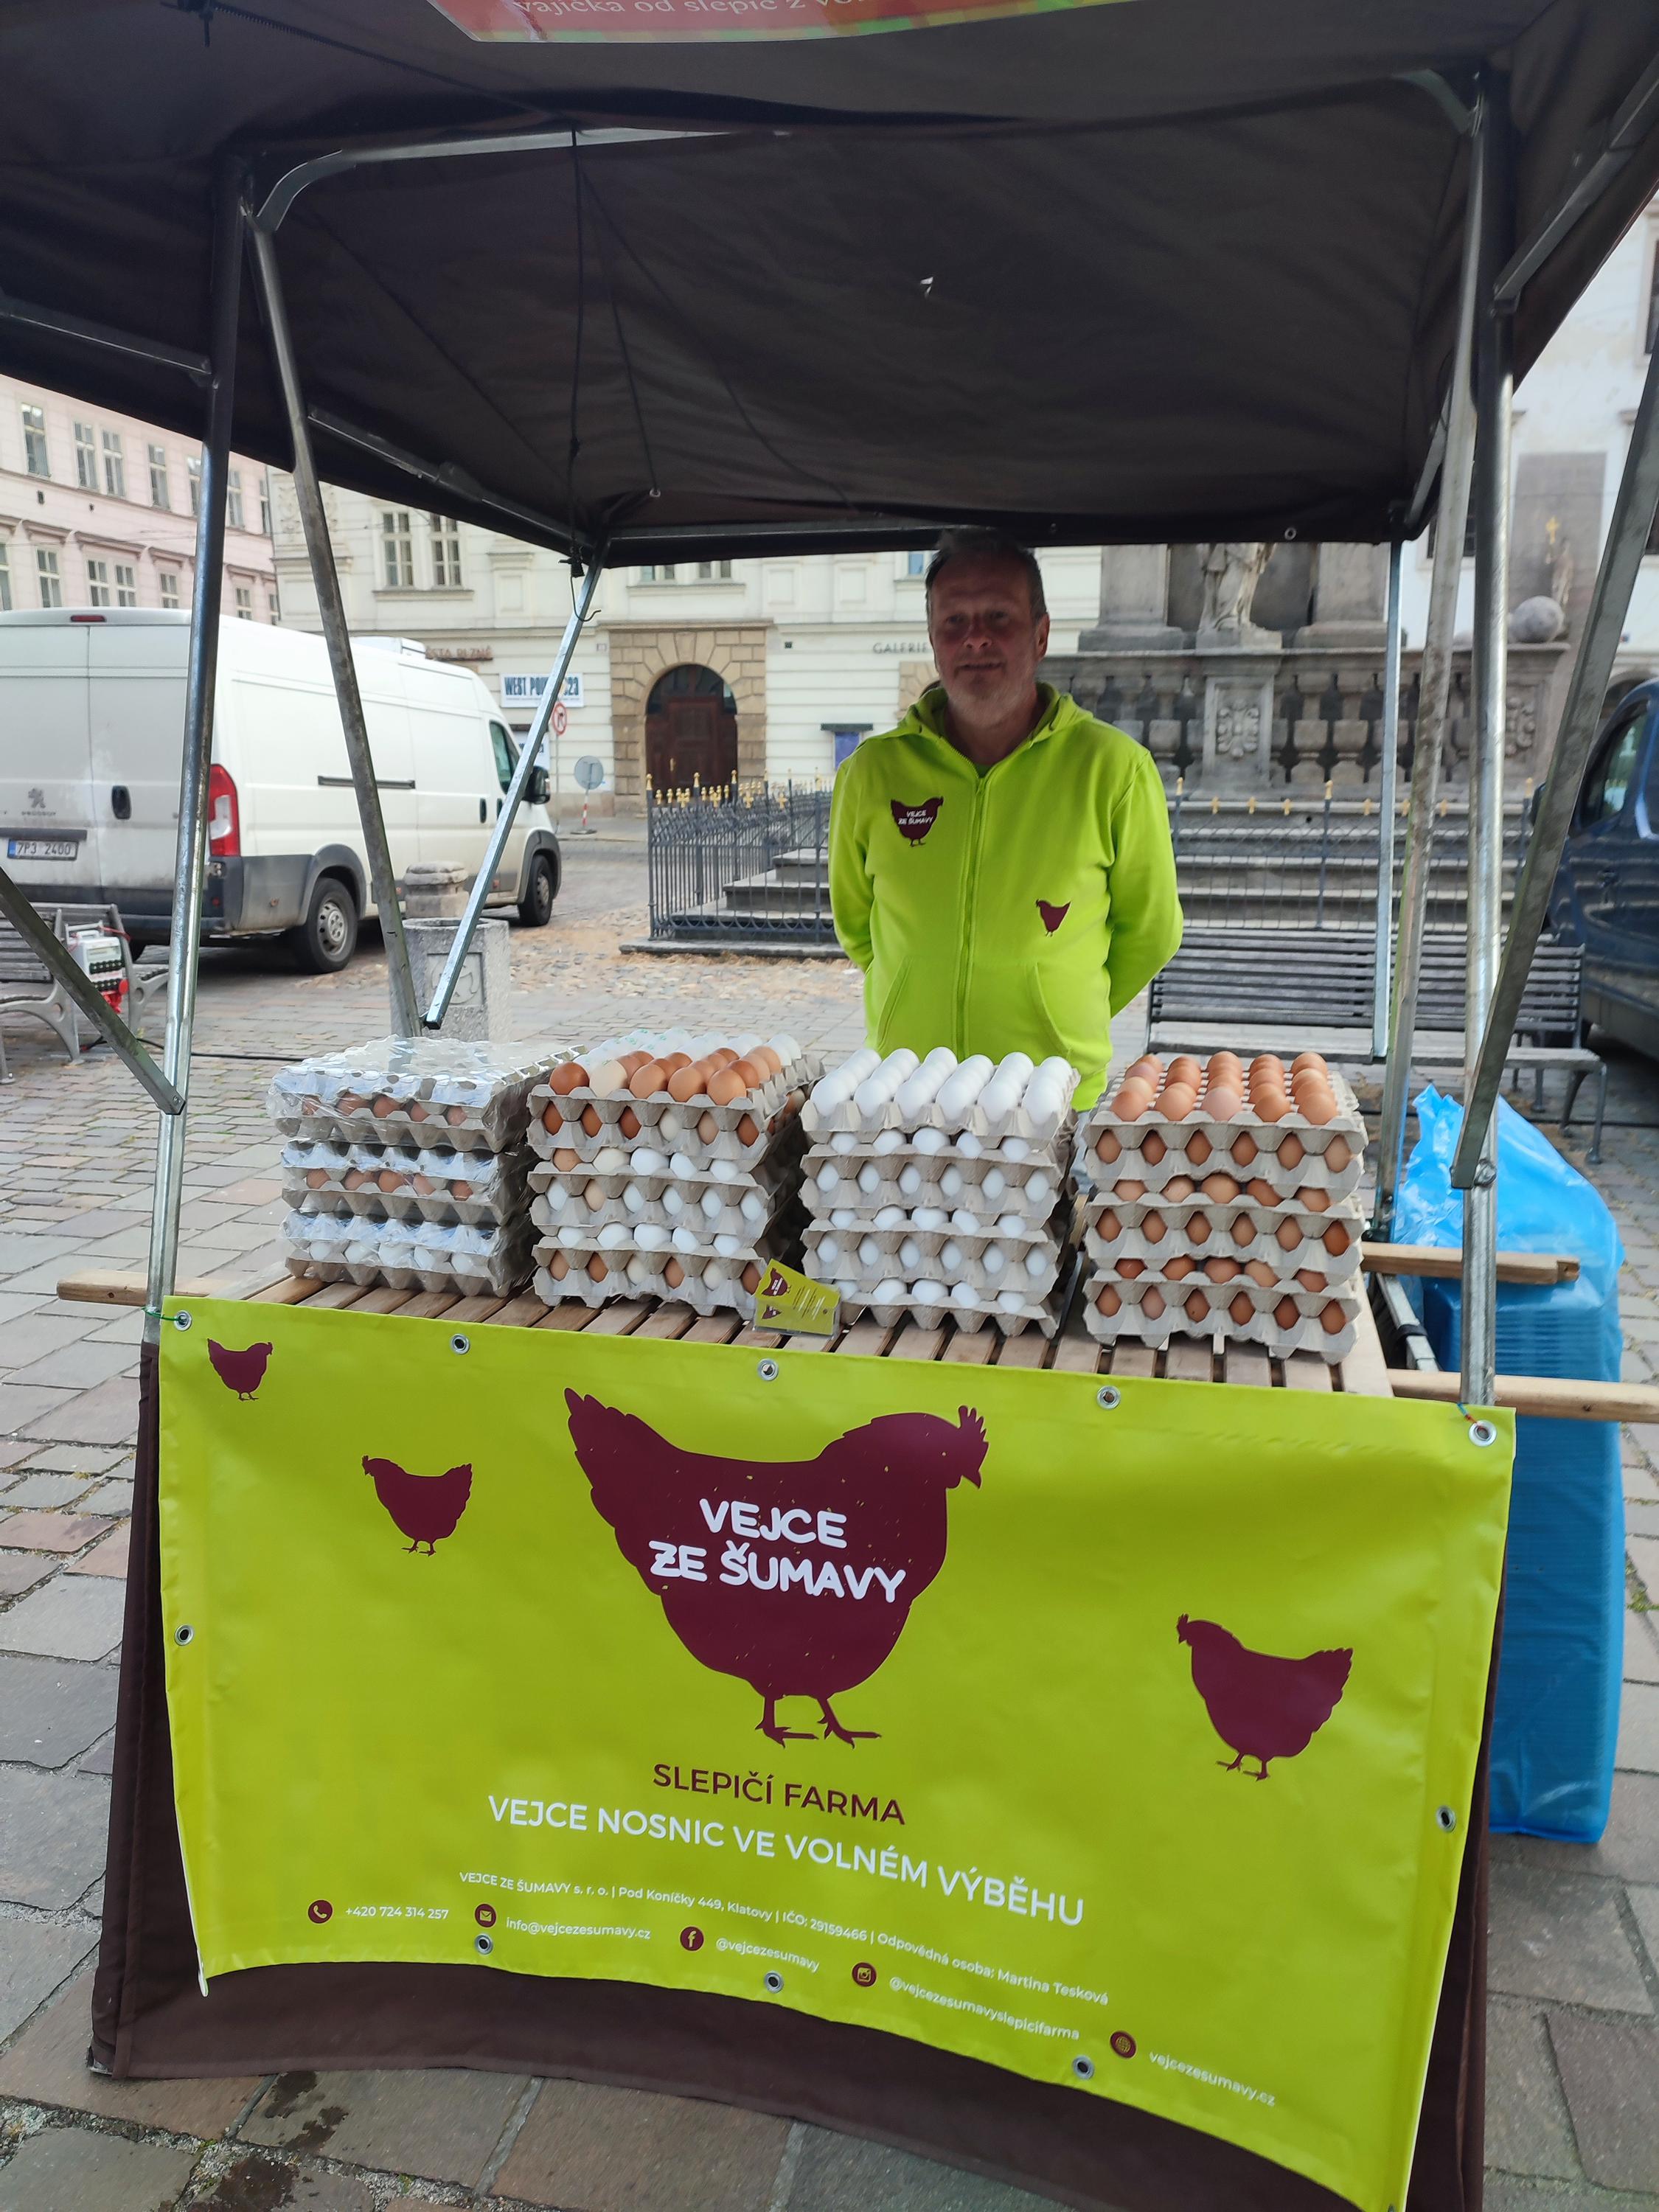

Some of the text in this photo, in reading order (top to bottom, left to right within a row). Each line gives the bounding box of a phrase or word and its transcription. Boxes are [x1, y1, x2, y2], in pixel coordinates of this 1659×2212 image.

[504, 677, 526, 695] WEST
[17, 842, 37, 854] 7P3
[699, 1498, 847, 1548] VEJCE
[648, 1540, 907, 1603] ZE ŠUMAVY
[653, 1764, 905, 1826] SLEPIČÍ FARMA
[488, 1795, 1084, 1926] VEJCE NOSNIC VE VOLNÉM VÝBĚHU
[345, 1905, 449, 1920] +420 724 314 257
[459, 1871, 498, 1886] VEJCE
[500, 1877, 515, 1891] ZE
[516, 1879, 571, 1893] ŠUMAVY
[619, 1886, 644, 1899] Pod
[646, 1889, 695, 1907] Koníčky
[698, 1896, 725, 1912] 449,
[727, 1902, 773, 1922] Klatovy
[782, 1910, 808, 1927] IČO:
[810, 1918, 868, 1941] 29159466
[877, 1933, 949, 1966] Odpovědná
[952, 1958, 995, 1978] osoba:
[998, 1969, 1050, 1993] Martina
[1053, 1982, 1109, 2006] Tesková
[507, 1916, 651, 1940] info@vejcezesumavy.cz
[716, 1937, 820, 1973] @vejcezesumavy
[889, 1976, 1079, 2041] @vejcezesumavyslepicifarma
[1150, 2051, 1276, 2107] vejcezesumavy.cz
